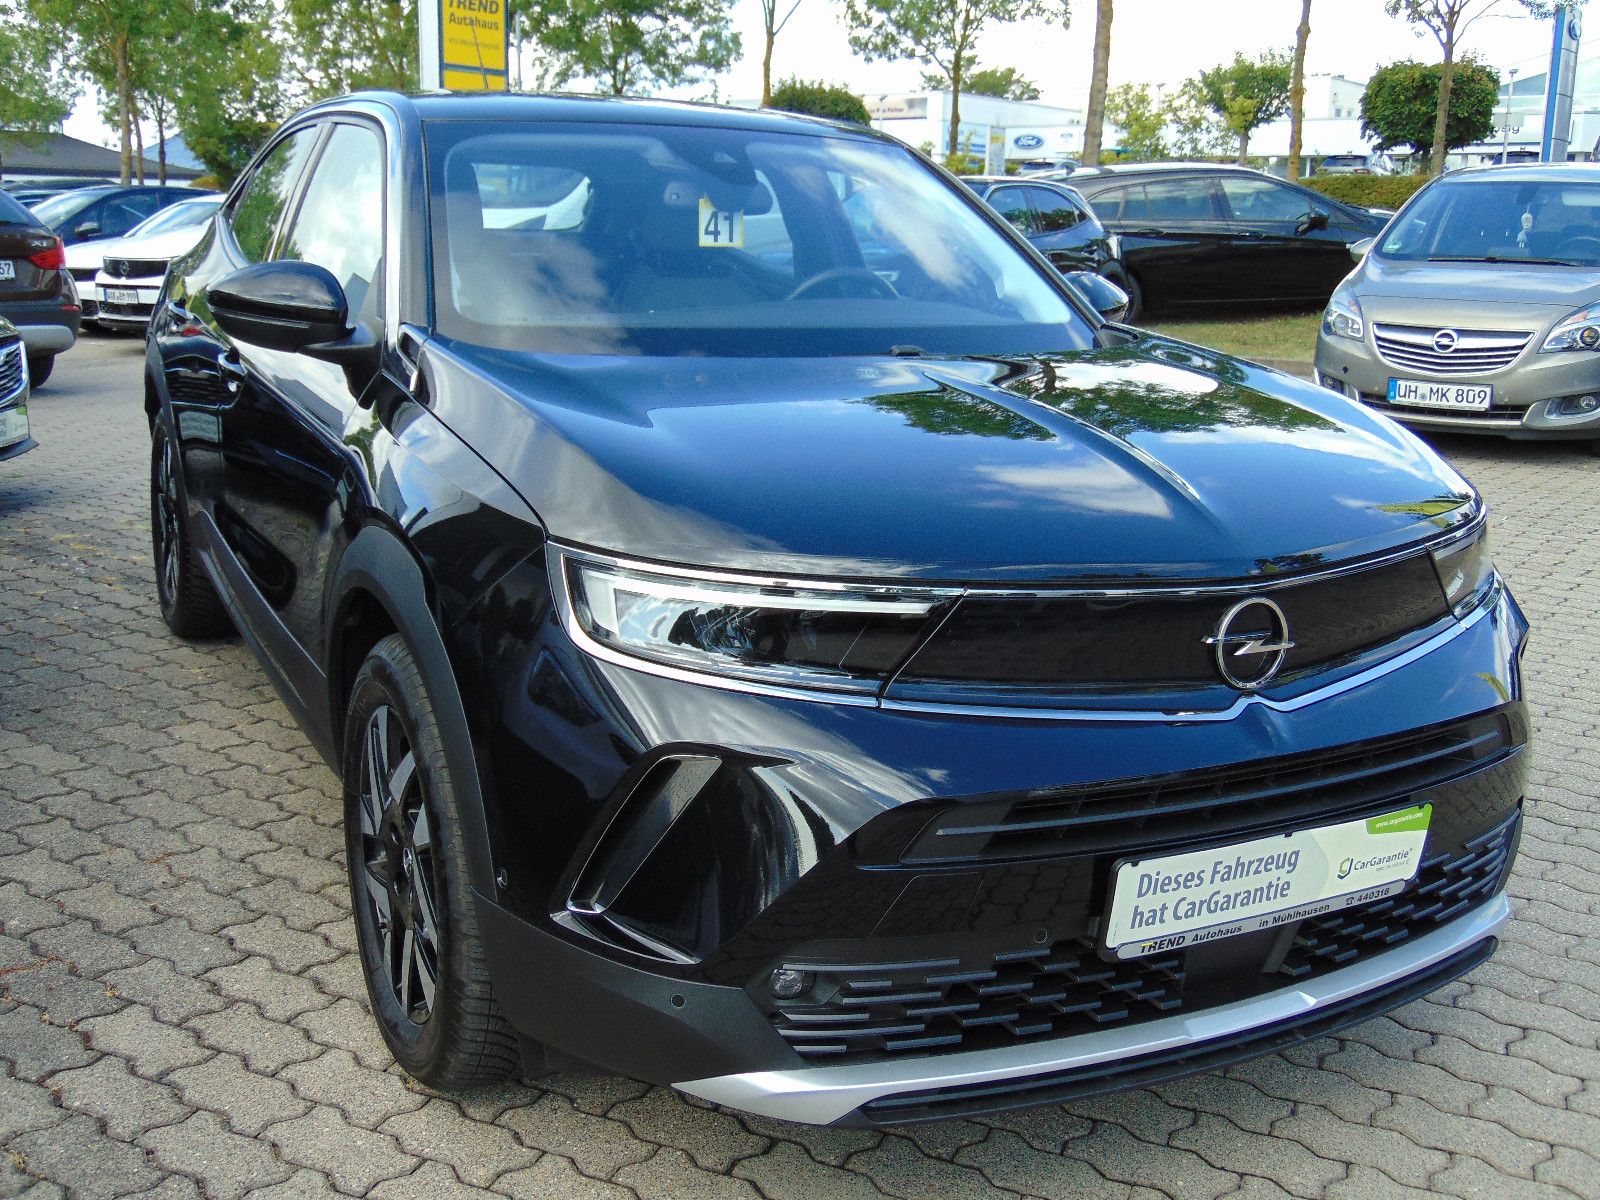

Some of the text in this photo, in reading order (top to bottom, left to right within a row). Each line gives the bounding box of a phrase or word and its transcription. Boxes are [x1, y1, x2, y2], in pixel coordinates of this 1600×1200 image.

[704, 210, 734, 243] 41
[1398, 384, 1488, 405] UH MK 809
[1137, 849, 1301, 899] Dieses Fahrzeug
[1130, 876, 1292, 930] hat CarGarantie
[1140, 887, 1390, 954] TREND Autohaus in Mühlhausen 440318
